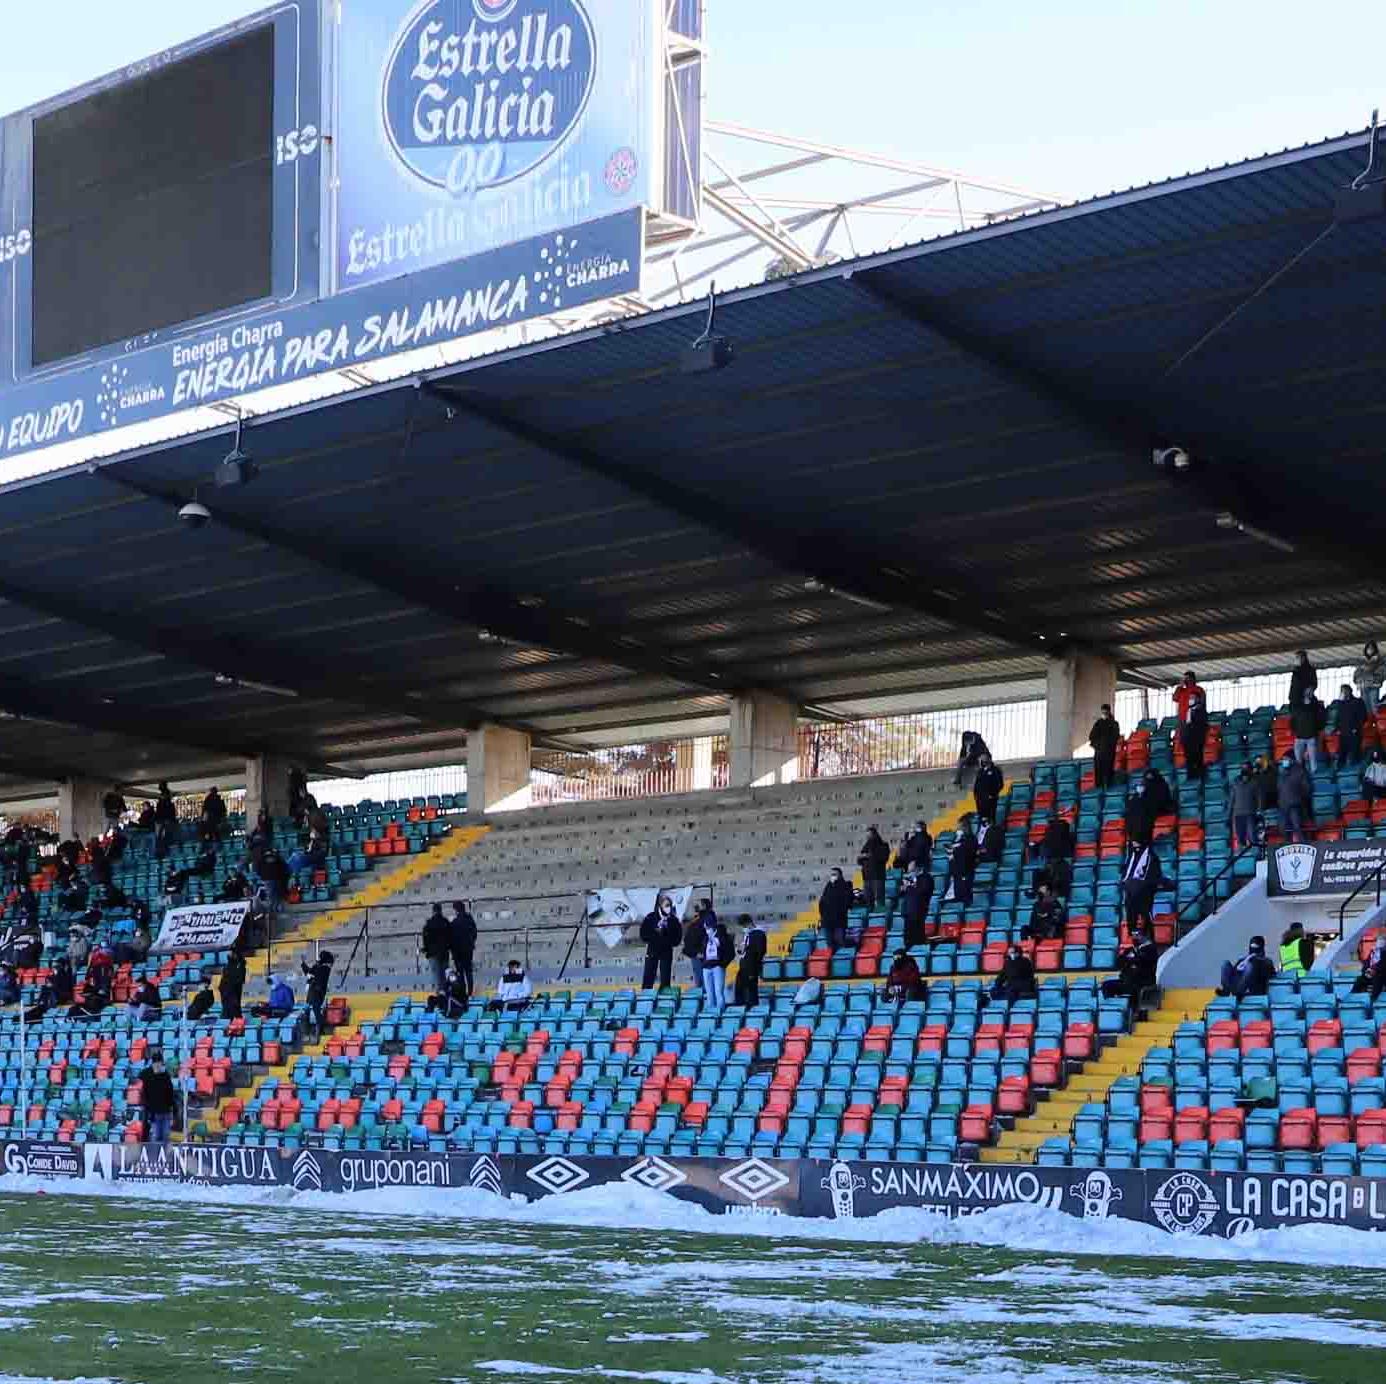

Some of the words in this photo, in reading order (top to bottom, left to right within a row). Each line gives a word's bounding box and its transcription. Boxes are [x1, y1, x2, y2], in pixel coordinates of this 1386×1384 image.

[411, 13, 573, 81] Estrella
[413, 77, 555, 142] Galicia
[346, 206, 469, 276] Estrella
[566, 259, 630, 288] CHARRA
[172, 345, 277, 405] ENERGÍA
[281, 325, 349, 375] PARA
[354, 275, 528, 356] SALAMANCA
[172, 338, 229, 367] Energía
[231, 318, 284, 348] Charra
[8, 399, 85, 449] EQUIPO
[341, 1153, 450, 1192] gruponani
[1226, 1177, 1261, 1215] LA
[1271, 1179, 1347, 1219] CASA
